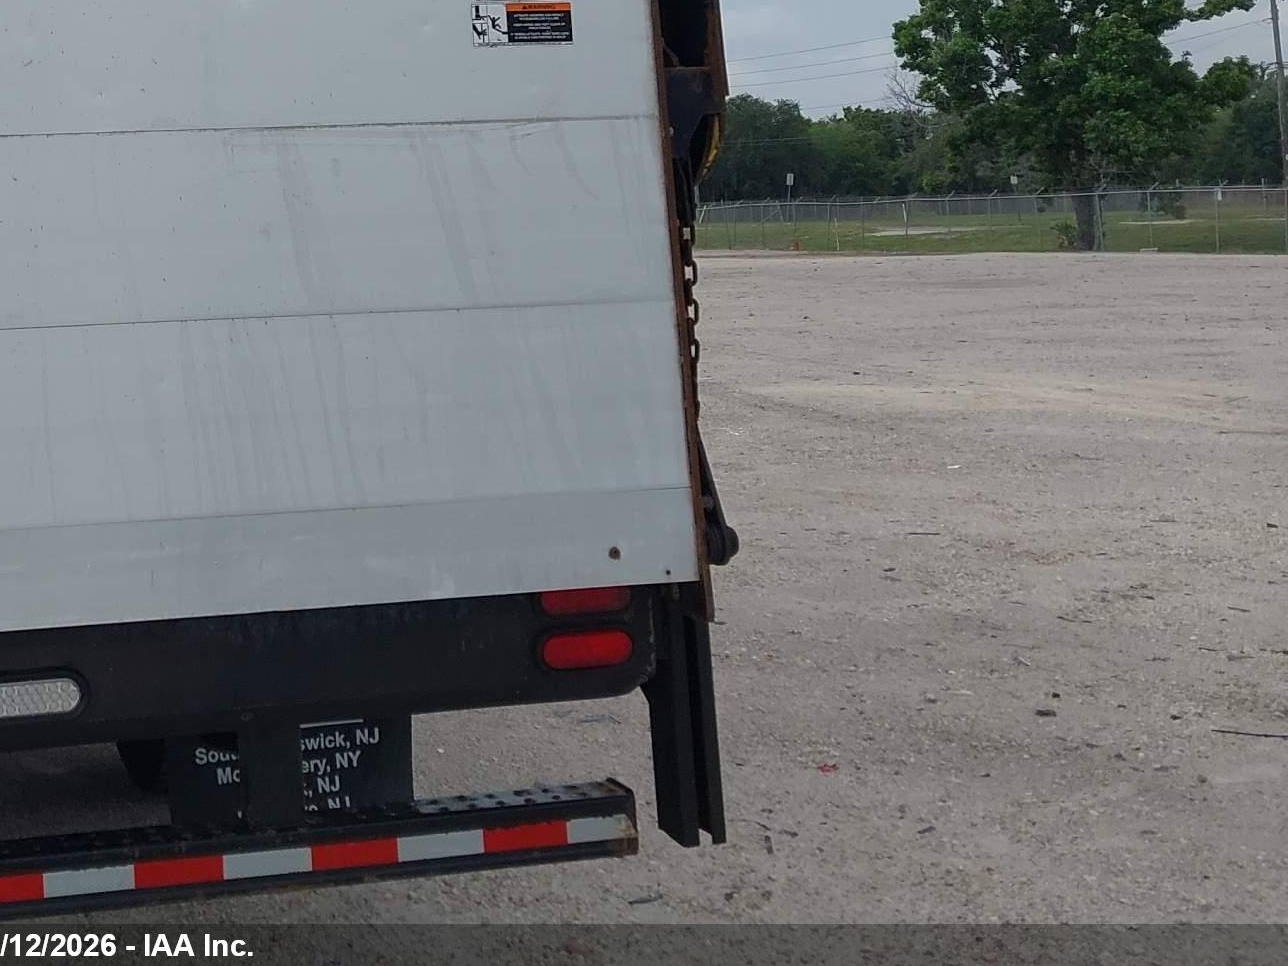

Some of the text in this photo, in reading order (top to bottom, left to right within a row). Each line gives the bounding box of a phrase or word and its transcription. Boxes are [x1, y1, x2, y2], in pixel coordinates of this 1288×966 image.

[356, 727, 380, 745] NJ
[335, 750, 362, 769] NY
[317, 775, 340, 794] NJ
